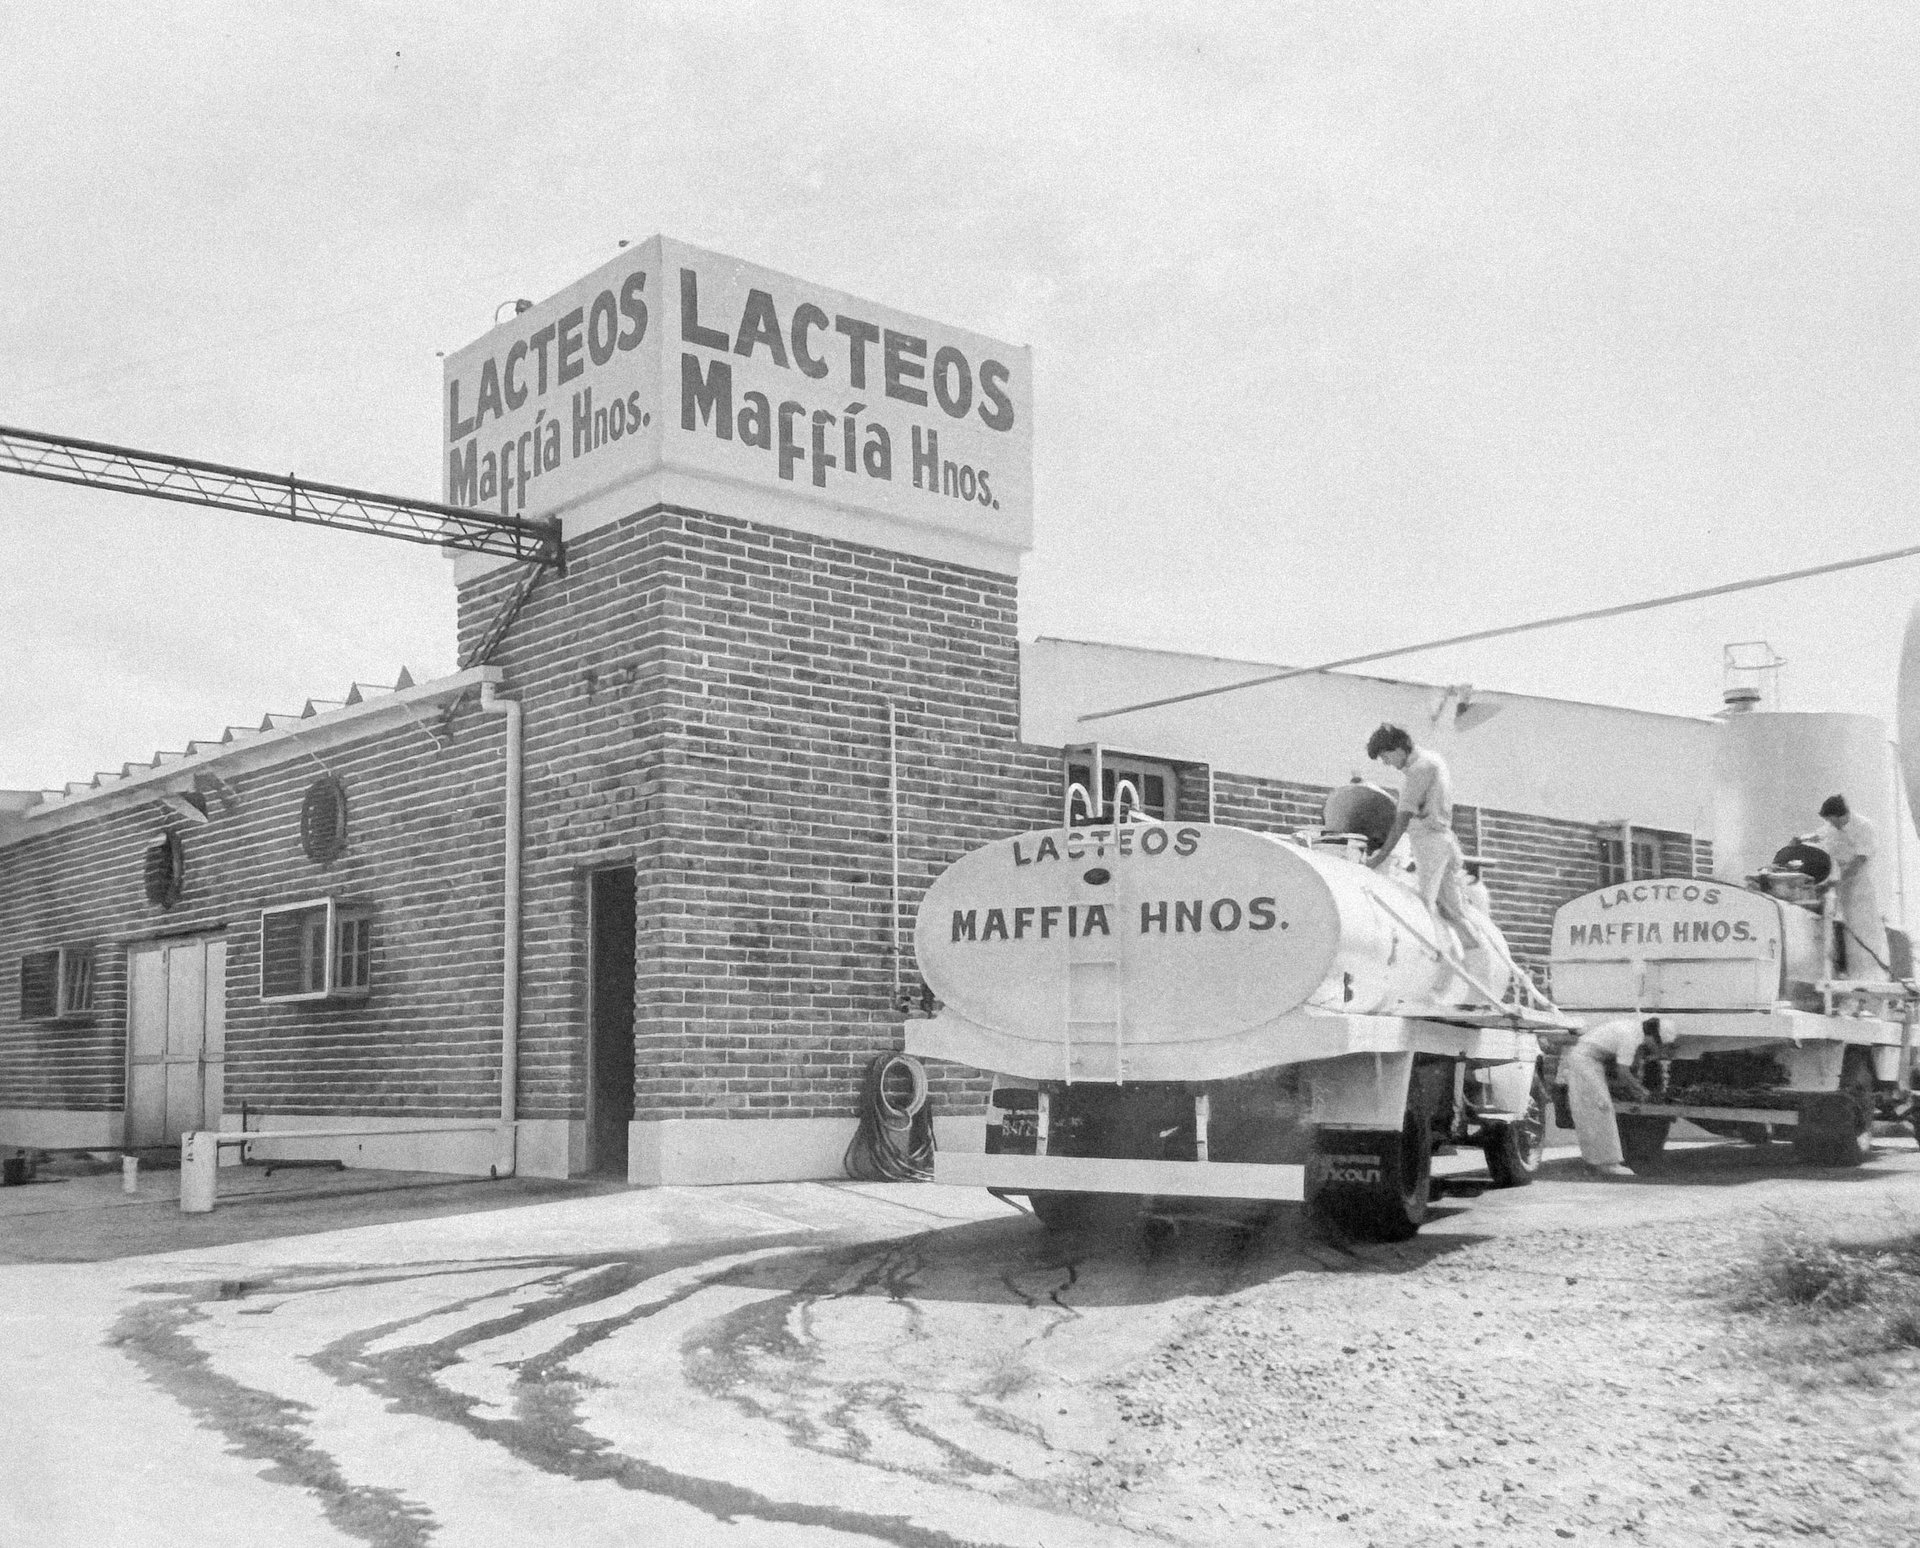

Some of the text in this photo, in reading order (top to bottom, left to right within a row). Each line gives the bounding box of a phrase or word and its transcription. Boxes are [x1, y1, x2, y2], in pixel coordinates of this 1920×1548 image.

[450, 271, 648, 443] LACTEOS
[680, 267, 1015, 432] LACTEOS
[450, 386, 650, 516] Maffía Hnos.
[681, 352, 1000, 511] Maffía Hnos.
[1013, 827, 1201, 867] LACTEOS
[950, 896, 1289, 943] MAFFIA HNOS.
[1570, 920, 1757, 946] MAFFIA HNOS.
[1601, 884, 1721, 909] LACTEOS
